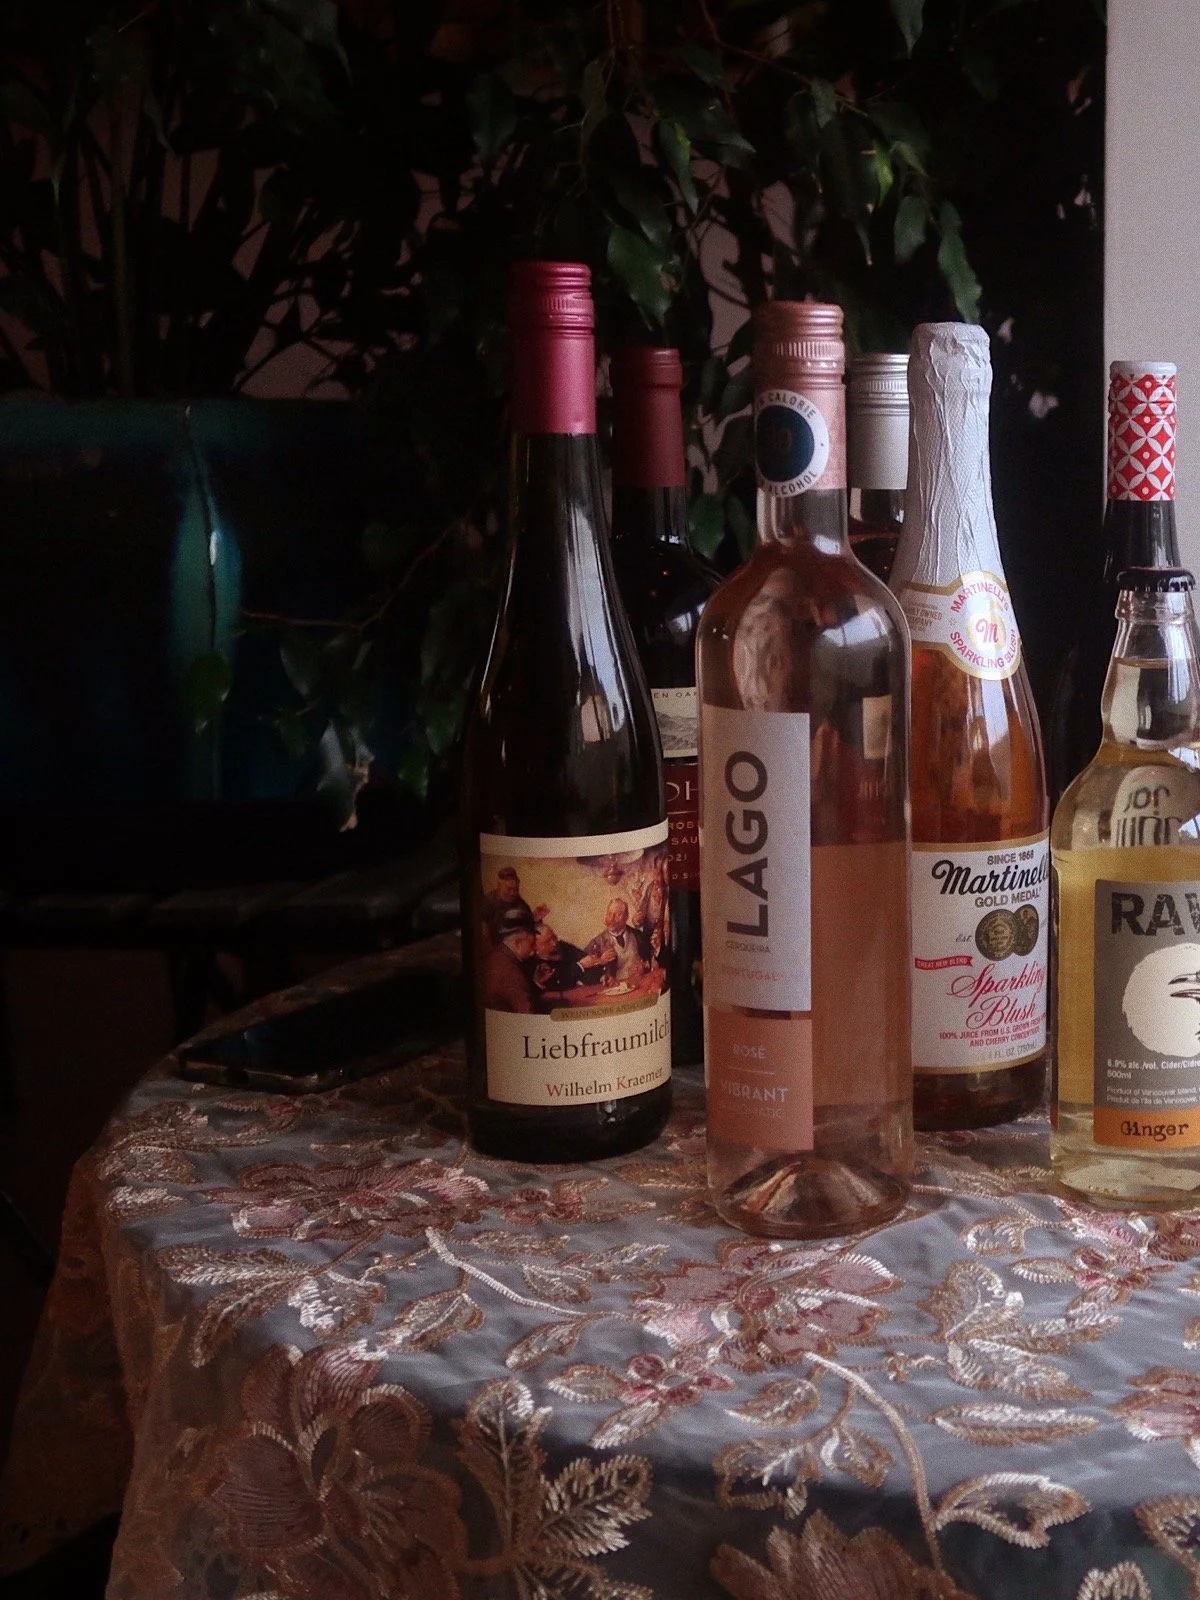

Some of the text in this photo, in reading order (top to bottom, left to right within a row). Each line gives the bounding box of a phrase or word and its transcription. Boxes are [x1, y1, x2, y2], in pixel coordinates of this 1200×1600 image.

[767, 392, 816, 419] CALORIE
[768, 471, 817, 497] ALCOHOL
[950, 631, 1004, 668] SPARKLING
[725, 750, 769, 938] LAGO
[987, 853, 1016, 866] SINCE
[975, 888, 1040, 908] GOLD MEDAL
[947, 961, 1045, 1009] Sparkling
[965, 993, 1037, 1030] Blush
[939, 1030, 957, 1040] 100%
[960, 1029, 979, 1039] JUICE
[980, 1028, 999, 1037] FROM
[969, 1039, 984, 1048] AND
[546, 1066, 663, 1098] Wilhelm Kraemer
[1120, 1120, 1189, 1142] Ginger
